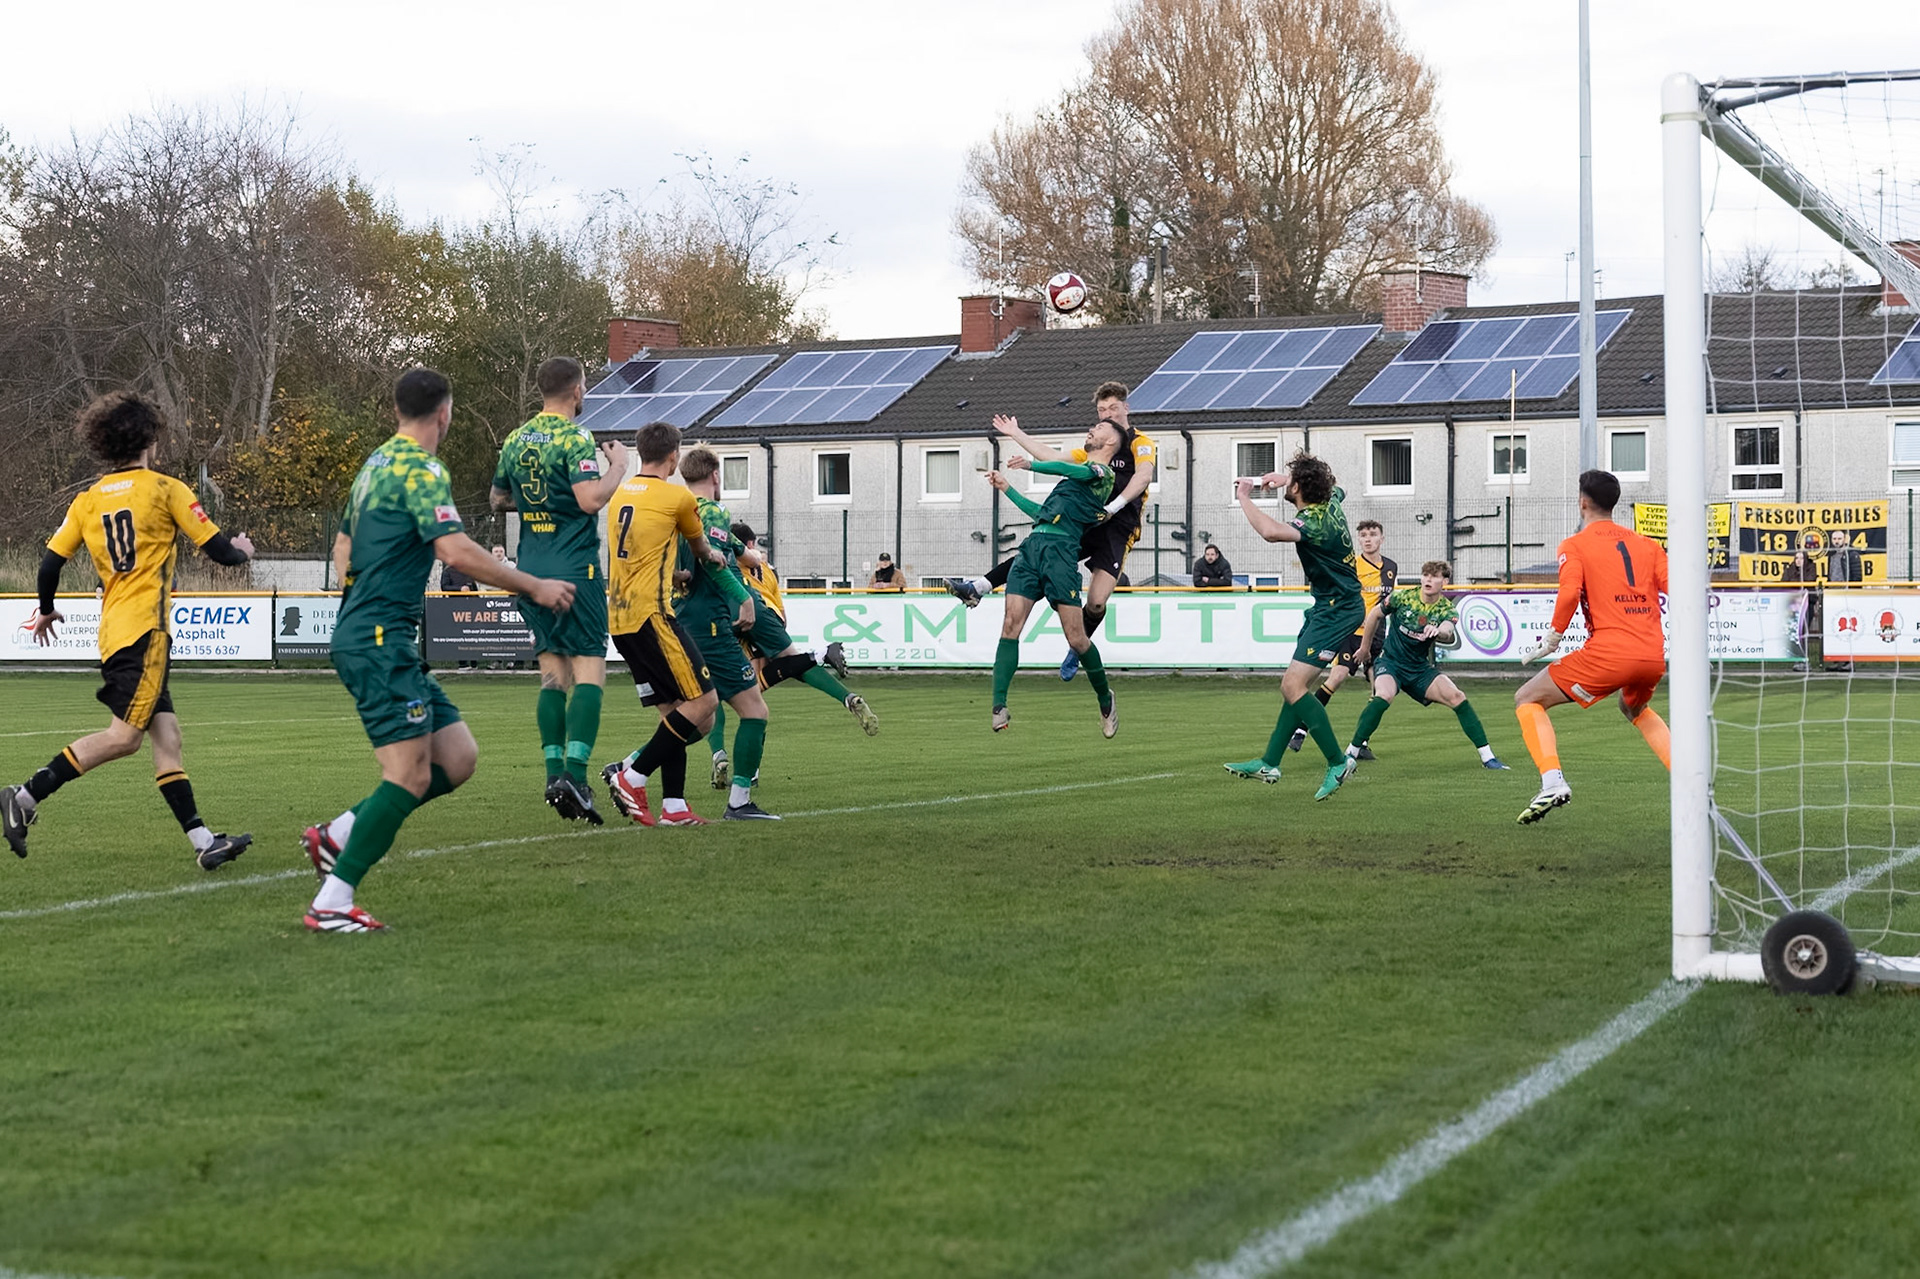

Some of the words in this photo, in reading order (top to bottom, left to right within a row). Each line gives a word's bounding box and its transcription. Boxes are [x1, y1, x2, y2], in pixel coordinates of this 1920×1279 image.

[519, 446, 548, 504] 3
[1745, 507, 1816, 525] PRESCOT
[1821, 506, 1881, 524] CABLES
[617, 505, 635, 559] 2
[102, 508, 136, 573] 10
[1760, 532, 1788, 552] 18
[1616, 540, 1636, 588] 1
[1614, 593, 1648, 603] KELLY'S
[174, 606, 252, 625] CEMEX
[452, 610, 473, 623] WE
[474, 610, 499, 623] ARE
[1624, 606, 1652, 615] WHARF
[175, 628, 226, 641] Asphalt
[52, 640, 73, 648] 0151
[75, 640, 91, 648] 236
[194, 645, 212, 656] 155
[214, 645, 240, 656] 6367
[884, 648, 936, 660] 1220
